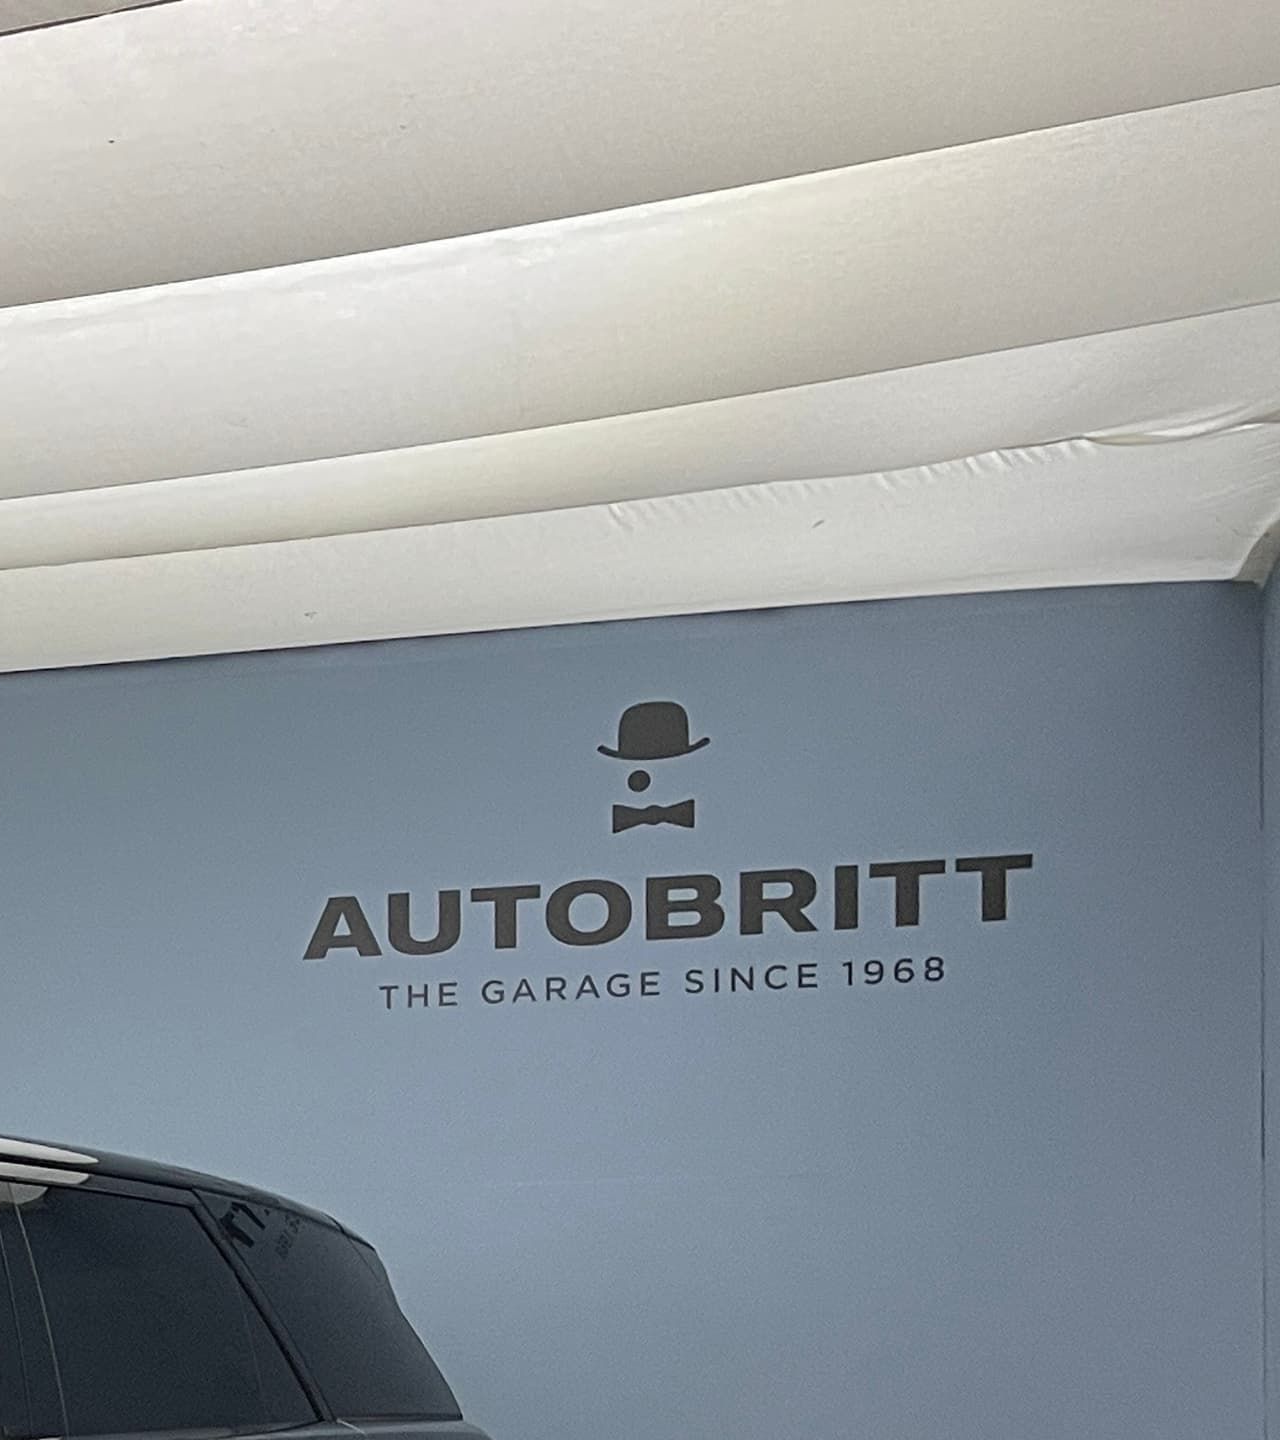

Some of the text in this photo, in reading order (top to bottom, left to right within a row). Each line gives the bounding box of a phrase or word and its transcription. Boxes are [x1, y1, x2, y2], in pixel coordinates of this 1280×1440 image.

[302, 853, 1035, 961] AUTOBRITT
[378, 956, 946, 1011] THE GARAGE SINCE 1968
